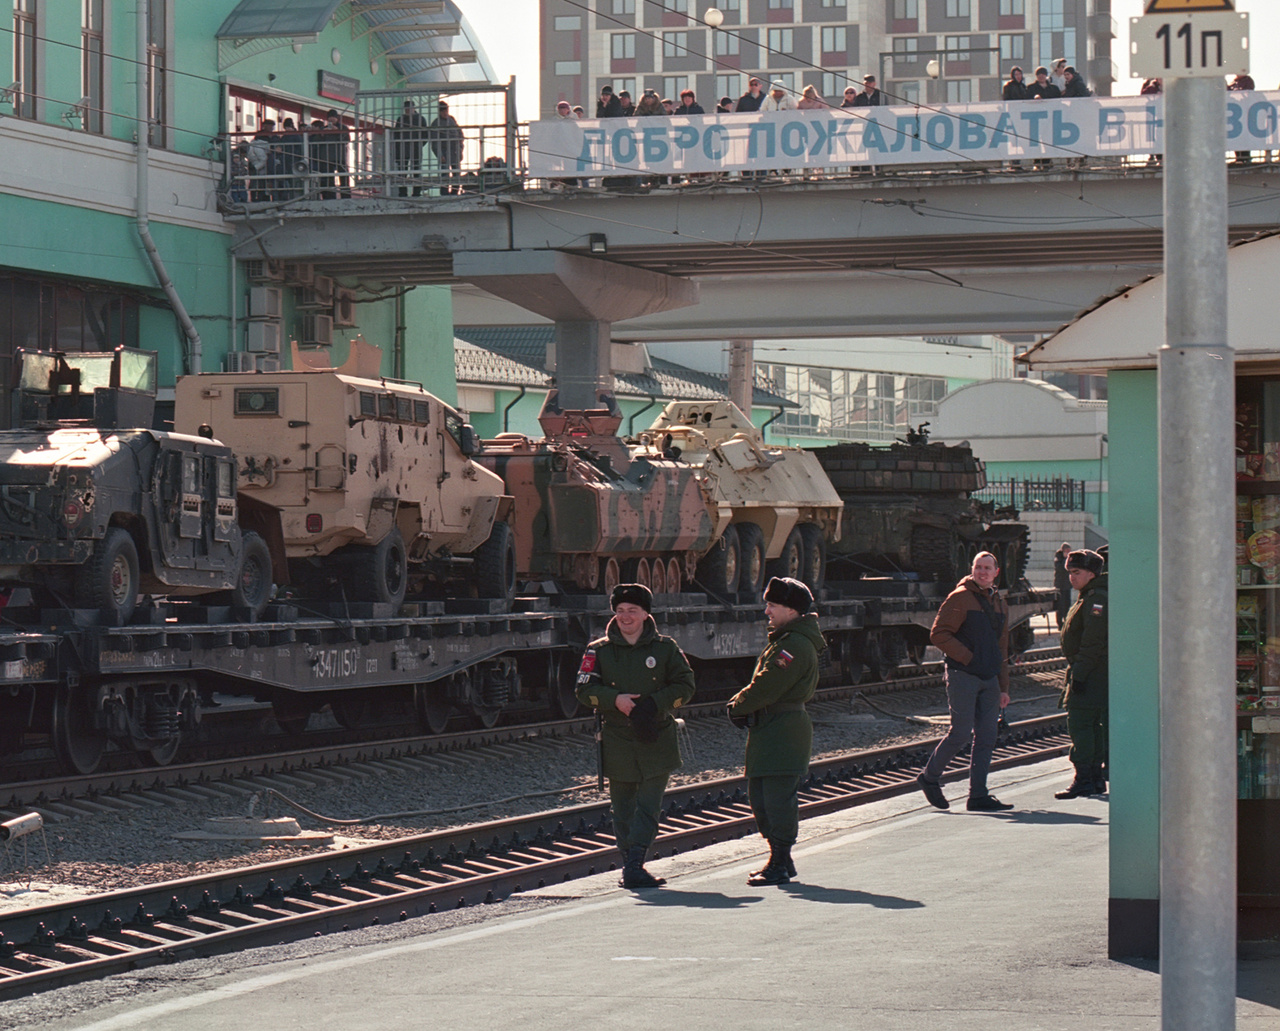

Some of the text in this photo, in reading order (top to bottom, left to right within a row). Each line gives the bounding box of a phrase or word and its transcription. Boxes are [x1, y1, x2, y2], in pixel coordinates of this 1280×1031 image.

[576, 124, 729, 172] ДОБРО
[748, 109, 1080, 159] ПОЖАЛОВАТЬ
[1098, 107, 1126, 144] В
